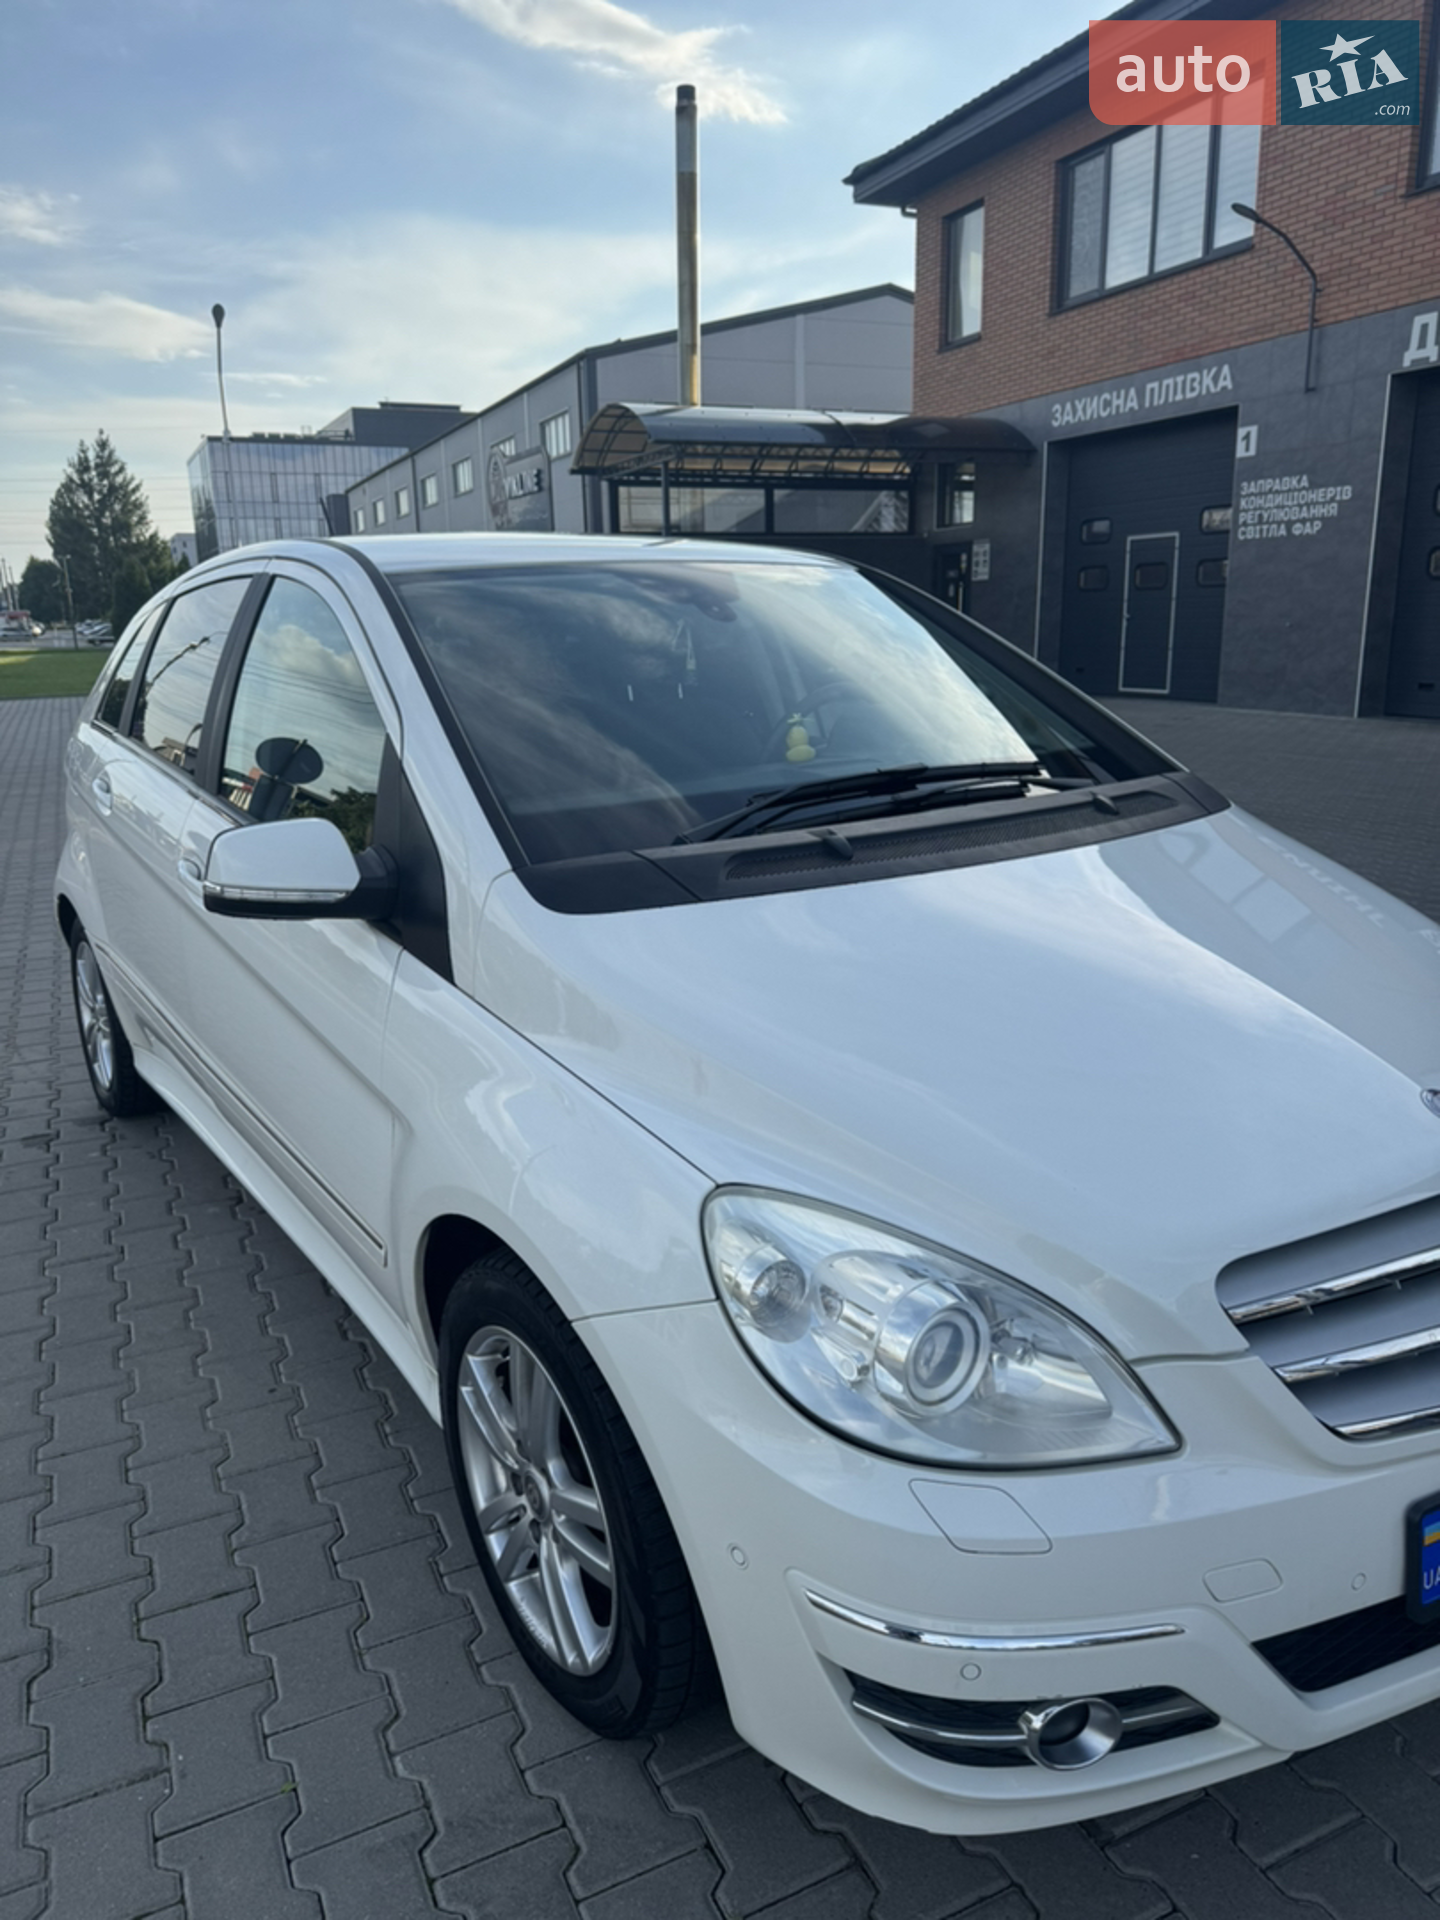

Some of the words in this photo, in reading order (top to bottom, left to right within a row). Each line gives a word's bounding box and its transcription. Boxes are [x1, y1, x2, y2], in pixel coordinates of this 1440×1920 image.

[1051, 386, 1139, 428] ЗАХИСНА
[1144, 363, 1233, 409] ПЛІВКА
[1240, 429, 1252, 454] 1
[1240, 474, 1309, 496] ЗАПРАВКА
[1239, 485, 1352, 510] КОНДИЦІОНЕРІВ
[1238, 502, 1338, 526] РЕГУЛЮВАННЯ
[1237, 524, 1287, 540] СВІТЛА
[1291, 520, 1322, 536] ФАР
